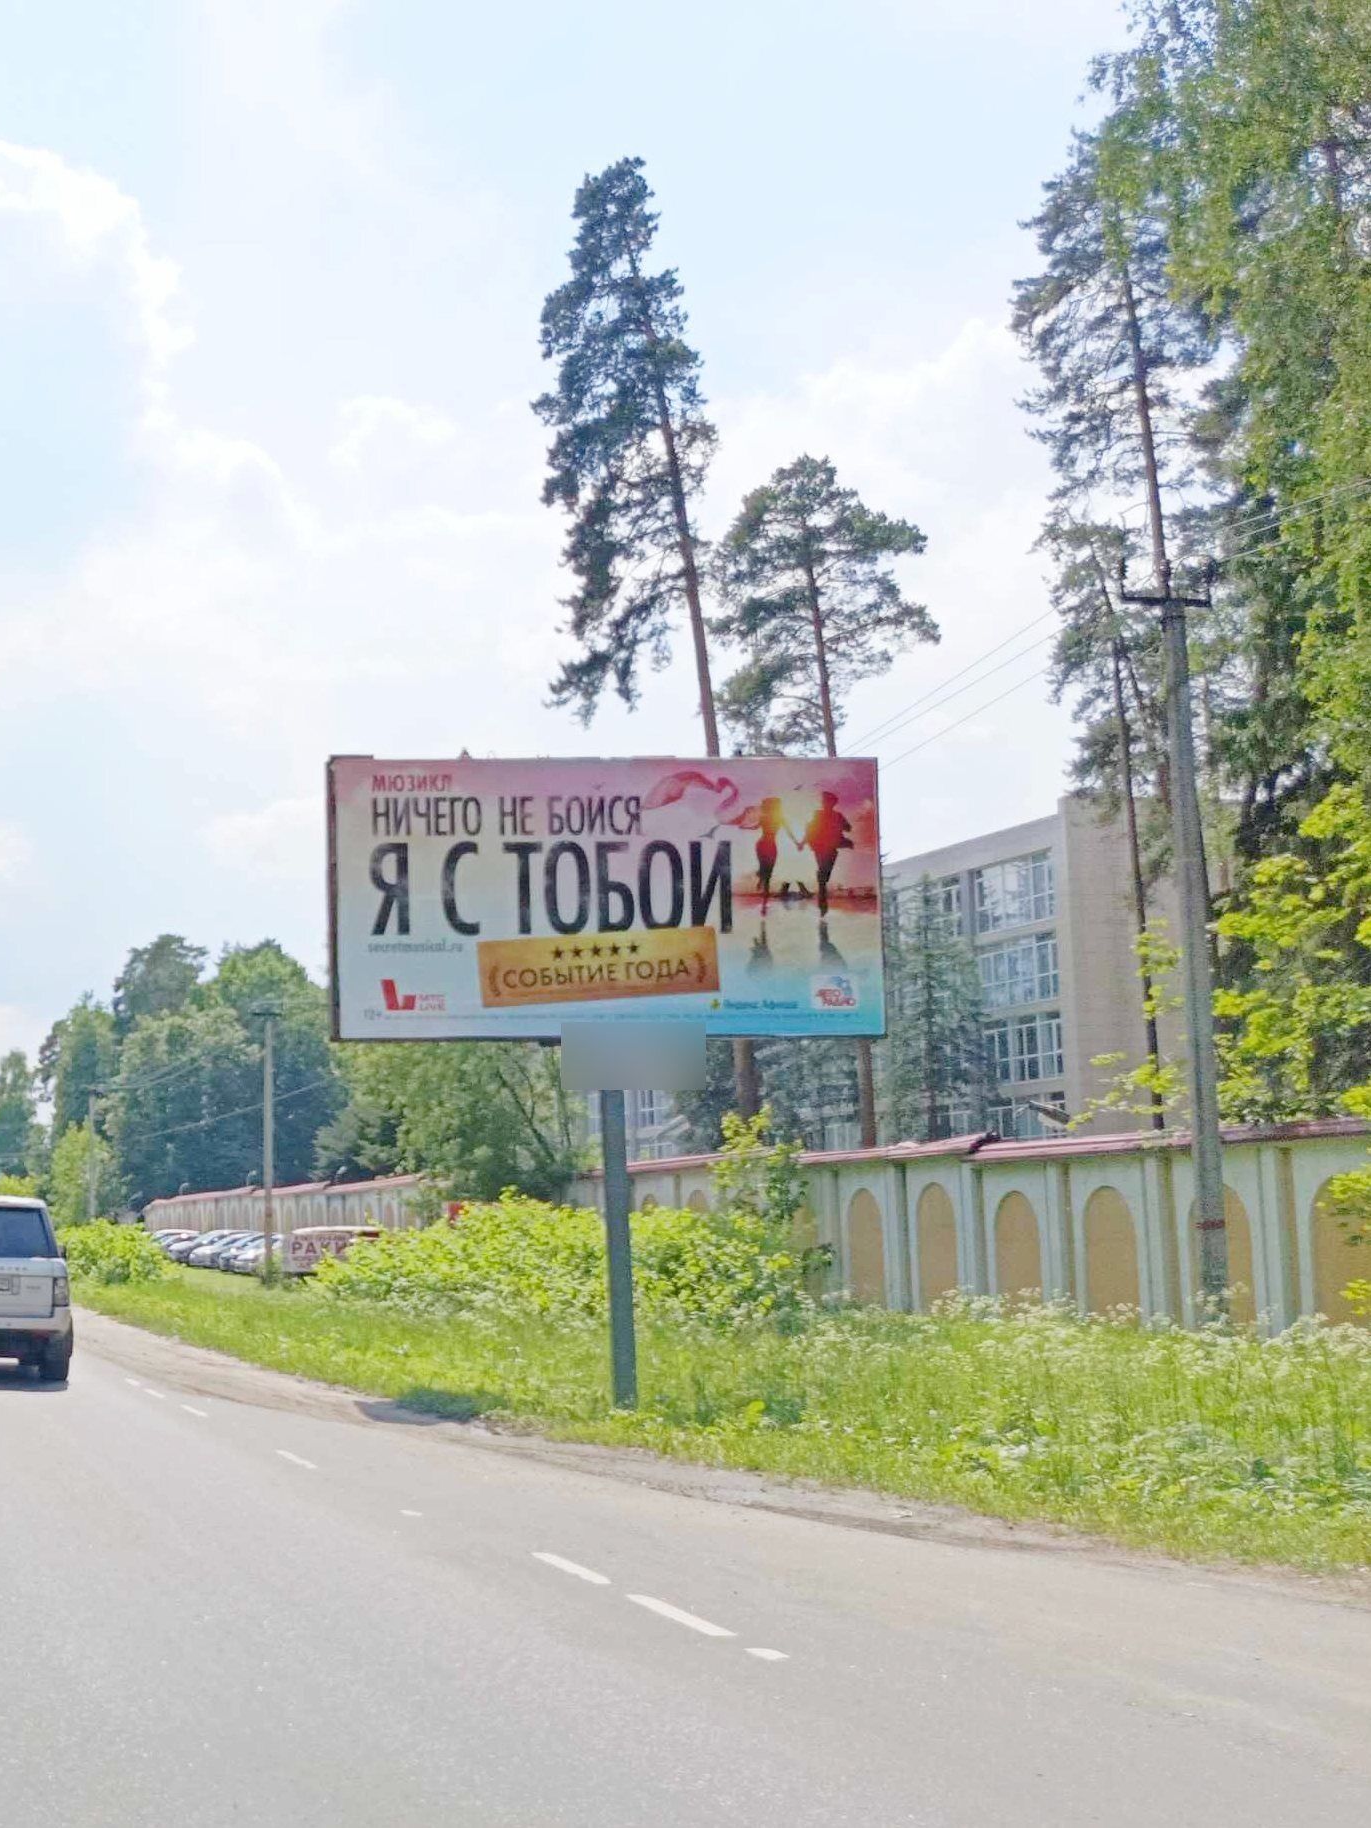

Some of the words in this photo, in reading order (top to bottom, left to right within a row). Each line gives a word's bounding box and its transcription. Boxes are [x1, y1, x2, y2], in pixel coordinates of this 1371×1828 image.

[372, 775, 452, 792] МЮЗИКЛ
[372, 796, 482, 837] НИЧЕГО
[499, 796, 534, 836] НЕ
[548, 783, 642, 836] БОЙСЯ
[369, 841, 410, 935] Я
[442, 840, 480, 935] С
[503, 827, 733, 935] ТОБОЙ
[503, 962, 617, 989] СОБЫТИЕ
[625, 958, 690, 982] ГОДА
